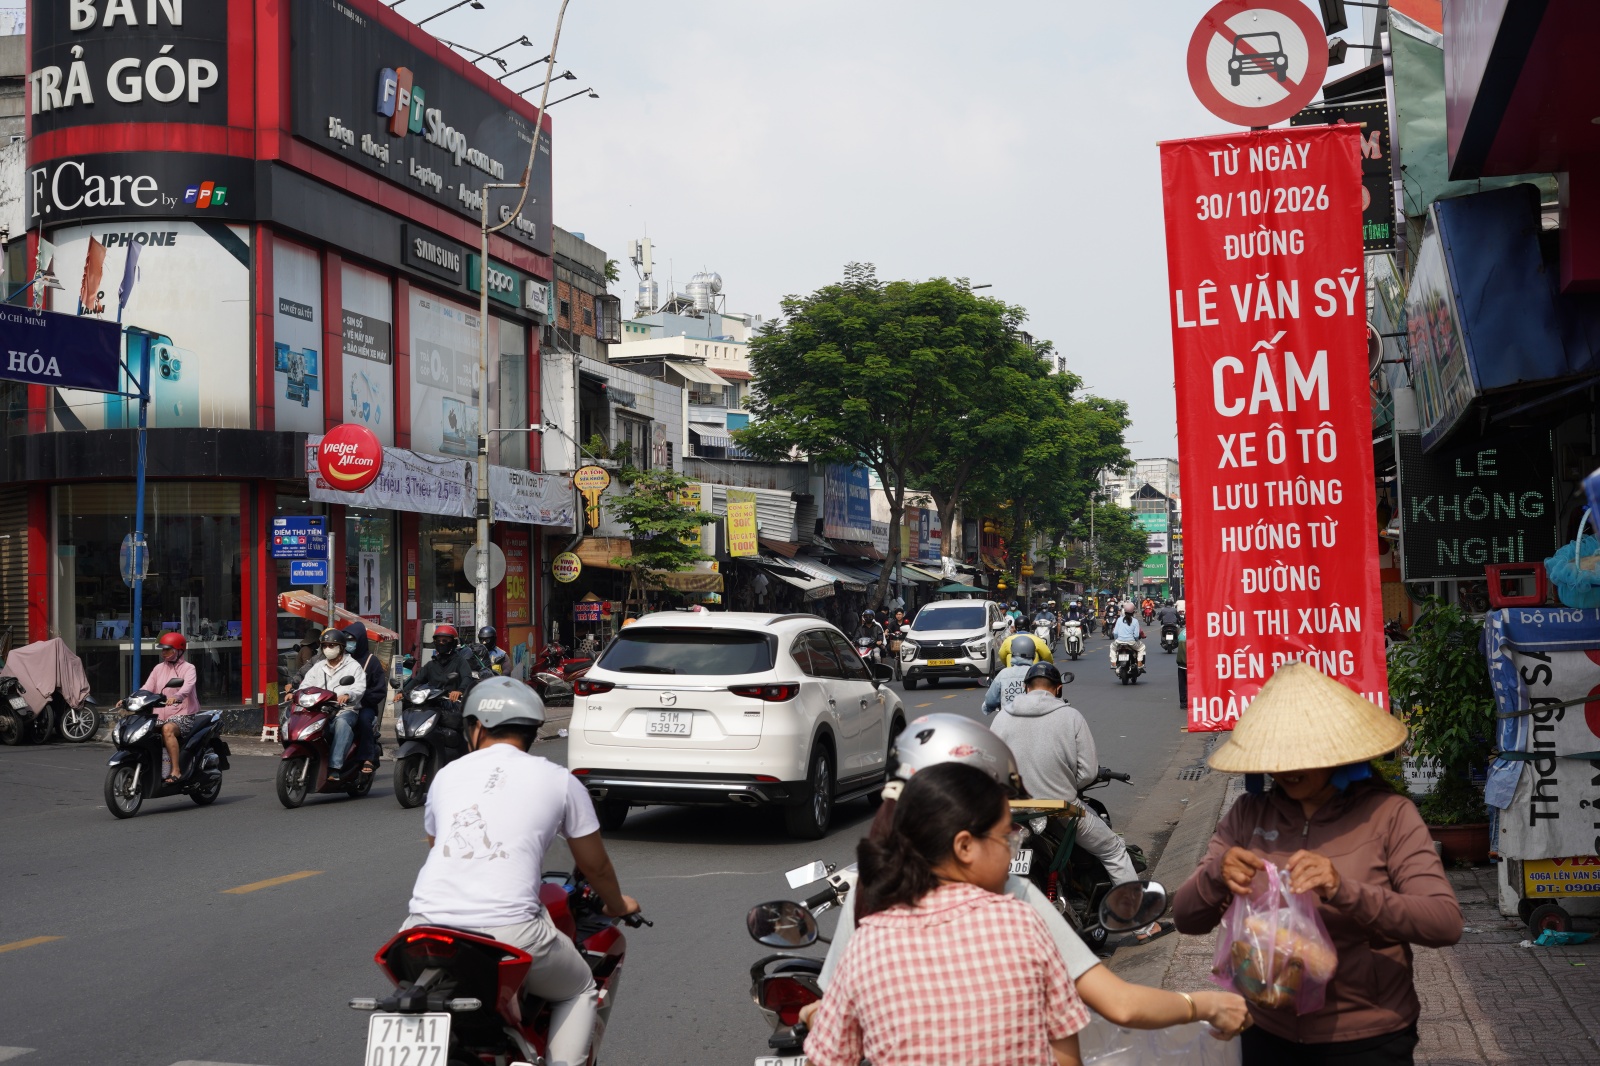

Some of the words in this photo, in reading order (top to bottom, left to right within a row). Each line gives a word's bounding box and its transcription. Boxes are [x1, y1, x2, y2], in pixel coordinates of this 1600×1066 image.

[28, 44, 94, 115] TRẢ
[106, 44, 219, 103] GÓP
[381, 76, 425, 125] FPT
[425, 107, 504, 180] Shop.com.vn
[329, 116, 354, 150] Điện
[361, 134, 389, 168] thoại
[410, 158, 442, 194] Laptop
[459, 183, 483, 211] Apple
[1208, 143, 1241, 177] TỪ
[1248, 138, 1312, 173] NGÀY
[31, 161, 158, 219] F.Care
[161, 193, 178, 209] by
[184, 184, 226, 203] FPT
[1196, 184, 1330, 221] 30/10/2026
[101, 231, 178, 248] IPHONE
[415, 238, 460, 273] SAMSUNG
[1223, 224, 1305, 261] ĐƯỜNG
[1175, 279, 1220, 329] LÊ
[1230, 272, 1300, 323] VĂN
[1314, 267, 1360, 318] SỸ
[8, 312, 23, 323] CHÍ
[25, 317, 47, 327] MINH
[7, 349, 62, 377] HÓA
[1213, 331, 1330, 417] CẤM
[1217, 432, 1258, 469] XE
[1267, 422, 1287, 465] Ô
[1296, 421, 1338, 464] TÔ
[1213, 483, 1259, 511] LƯU
[1264, 475, 1343, 507] THÔNG
[1411, 486, 1545, 523] KHÔNG
[734, 518, 751, 528] 30K
[1221, 518, 1301, 553] HƯỚNG
[1308, 516, 1339, 548] TỪ
[733, 541, 755, 551] 100K
[554, 565, 579, 573] KHÓA
[1241, 560, 1321, 594] ĐƯỜNG
[1207, 605, 1246, 638] BÙI
[1253, 609, 1290, 640] THỊ
[1298, 602, 1361, 635] XUÂN
[1520, 610, 1545, 628] bộ
[1549, 609, 1584, 623] nhớ
[1216, 645, 1265, 679] ĐẾN
[660, 712, 680, 723] 51M
[1193, 690, 1256, 723] HOÀN
[651, 723, 686, 734] 539.72
[1530, 872, 1551, 880] 406A
[1536, 885, 1560, 893] ĐT:
[381, 1019, 437, 1043] 71-A1
[373, 1046, 442, 1066] 01277
